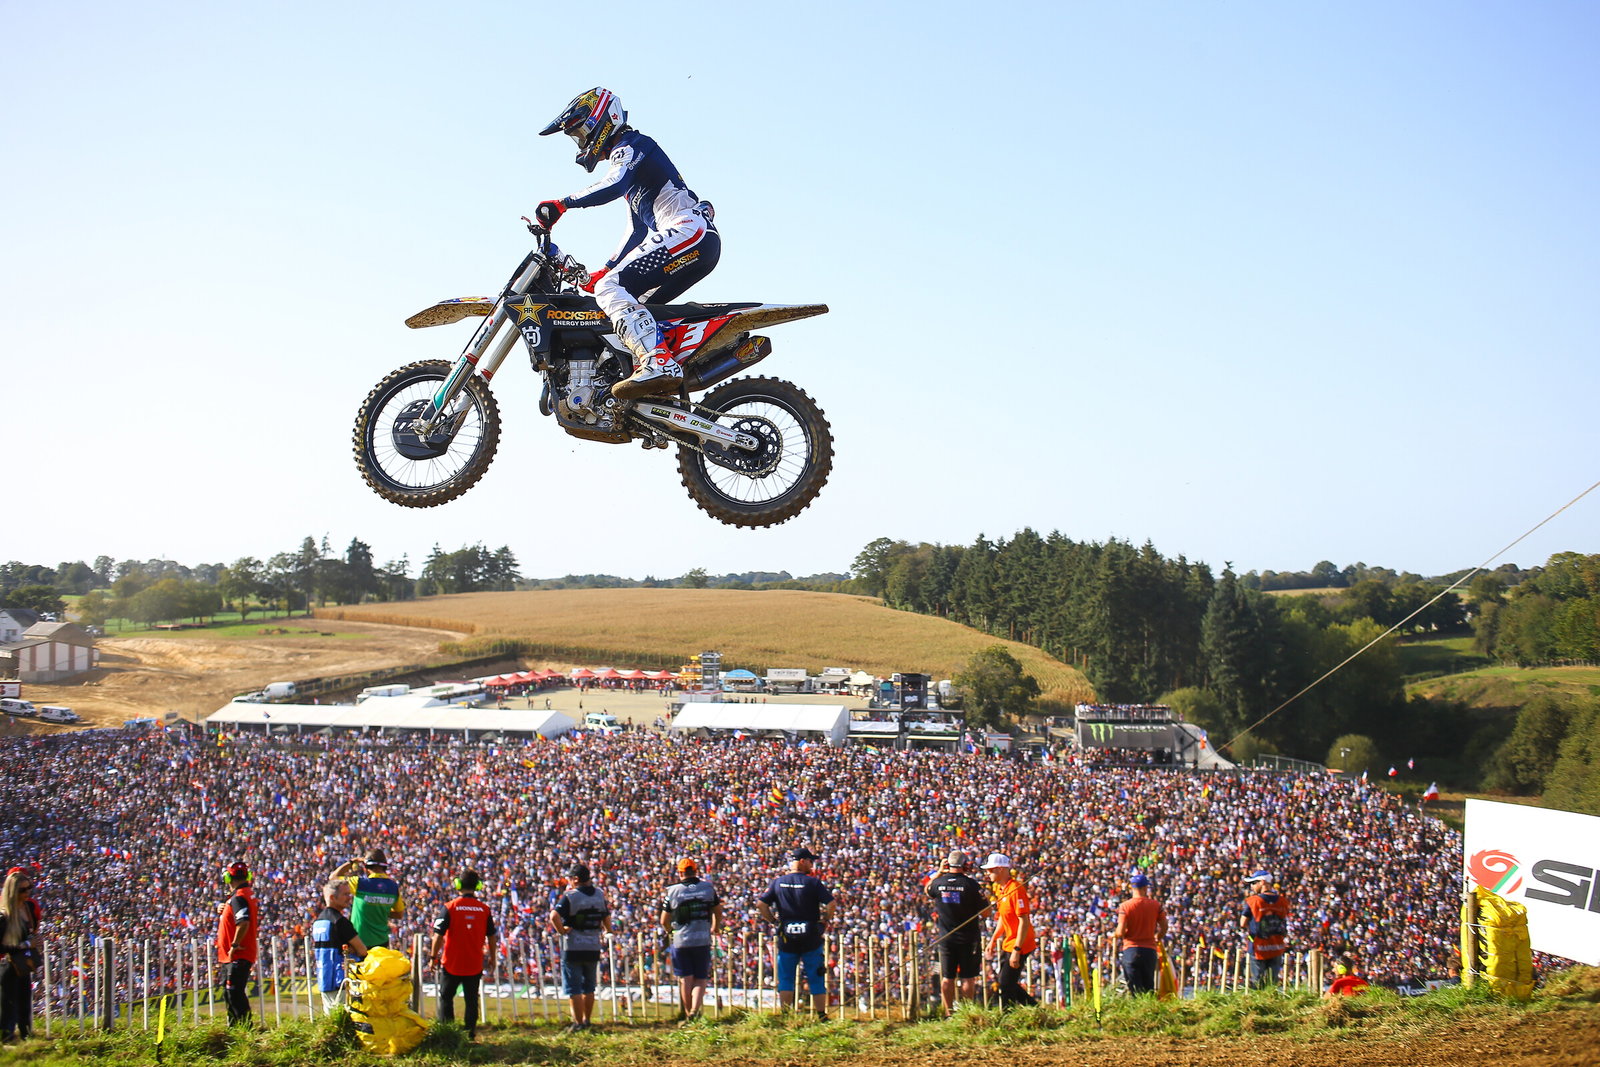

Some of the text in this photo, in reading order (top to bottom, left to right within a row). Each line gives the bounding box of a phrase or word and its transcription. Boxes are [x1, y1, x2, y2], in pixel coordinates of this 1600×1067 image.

[592, 120, 613, 156] ROCKSTAR
[663, 250, 700, 274] ROCKSTAR
[547, 310, 606, 320] ROCKSTAR
[680, 320, 710, 349] 3
[674, 413, 687, 422] RK
[1524, 859, 1600, 914] S
